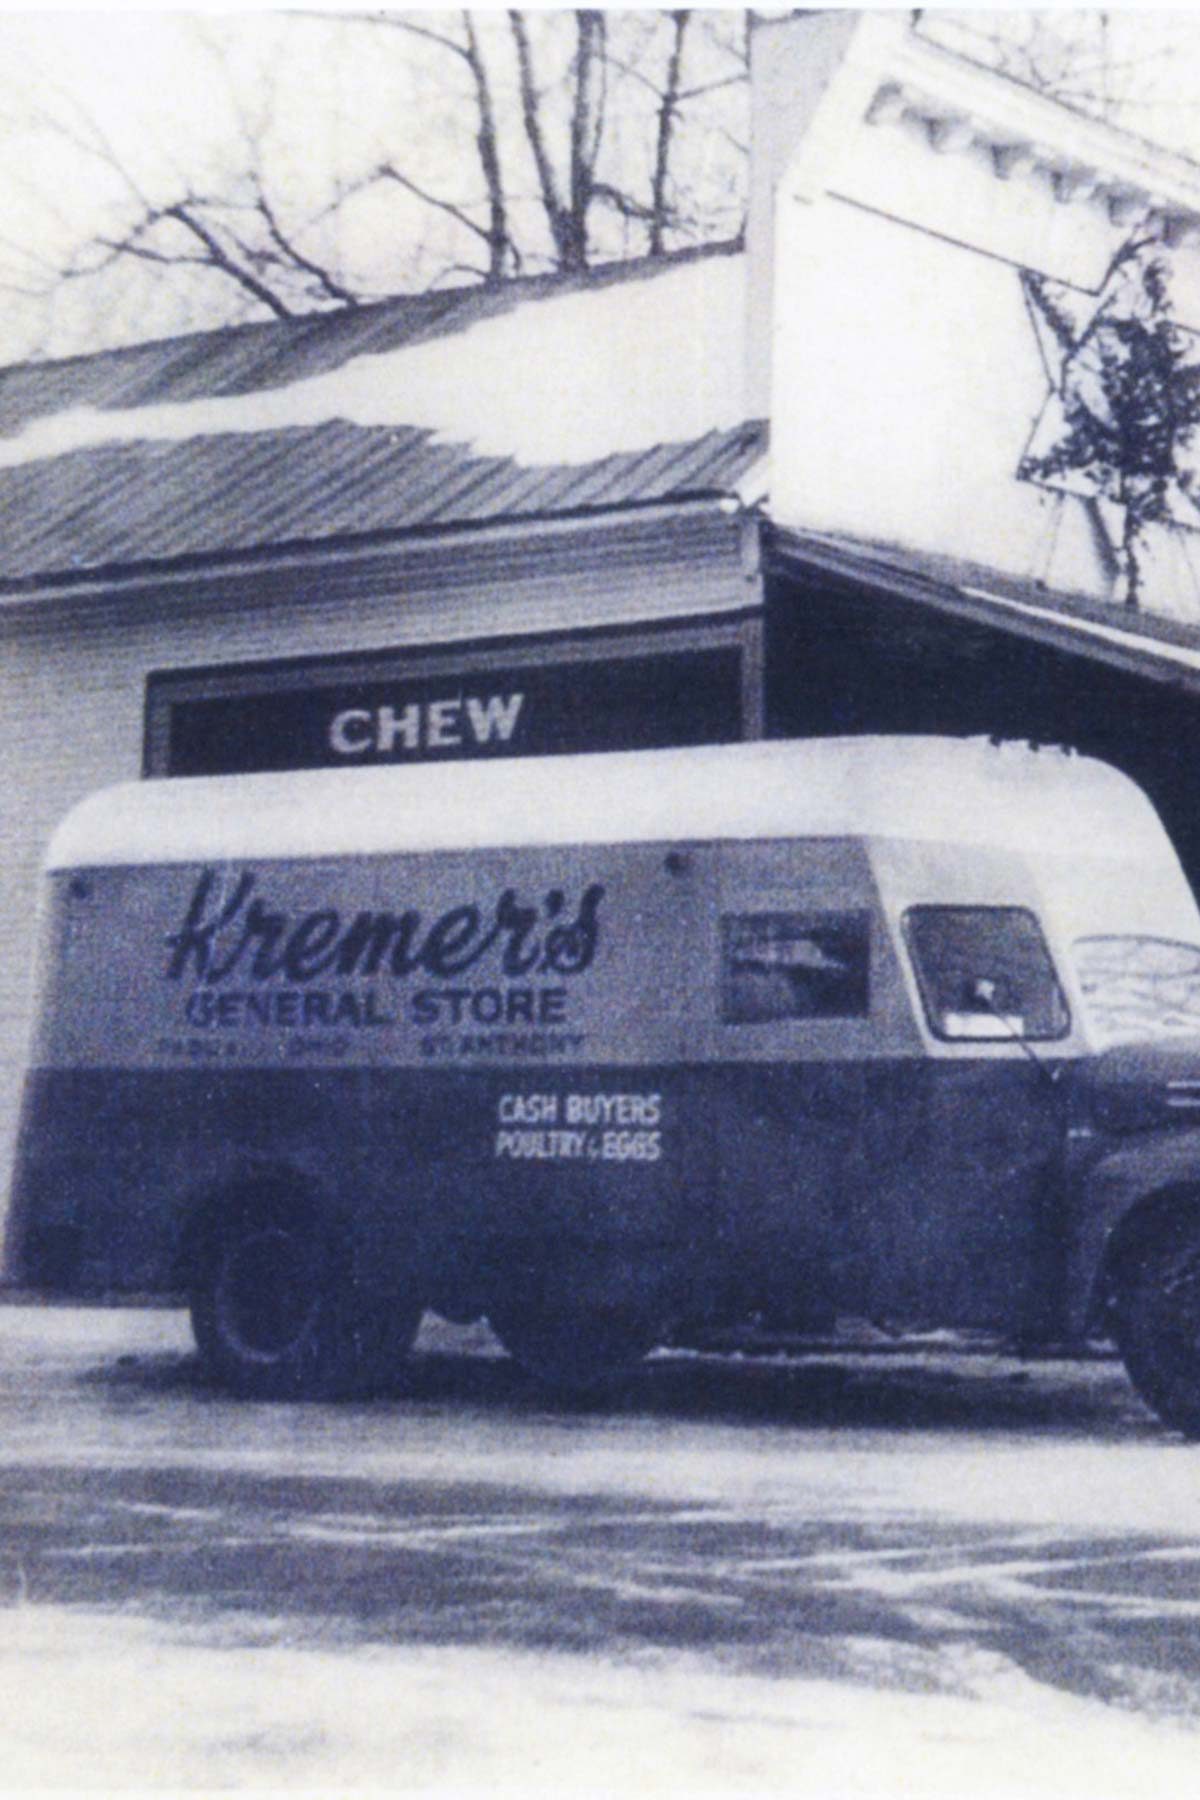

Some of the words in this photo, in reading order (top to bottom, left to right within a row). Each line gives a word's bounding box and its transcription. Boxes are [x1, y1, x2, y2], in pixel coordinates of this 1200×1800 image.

[329, 693, 525, 756] CHEW
[164, 868, 606, 984] Kremer's
[185, 990, 391, 1028] GENERAL
[411, 987, 569, 1025] STORE
[499, 1094, 558, 1124] CASH
[566, 1093, 663, 1126] BUYERS
[495, 1130, 587, 1159] POULTRY
[601, 1131, 663, 1162] EGGS
